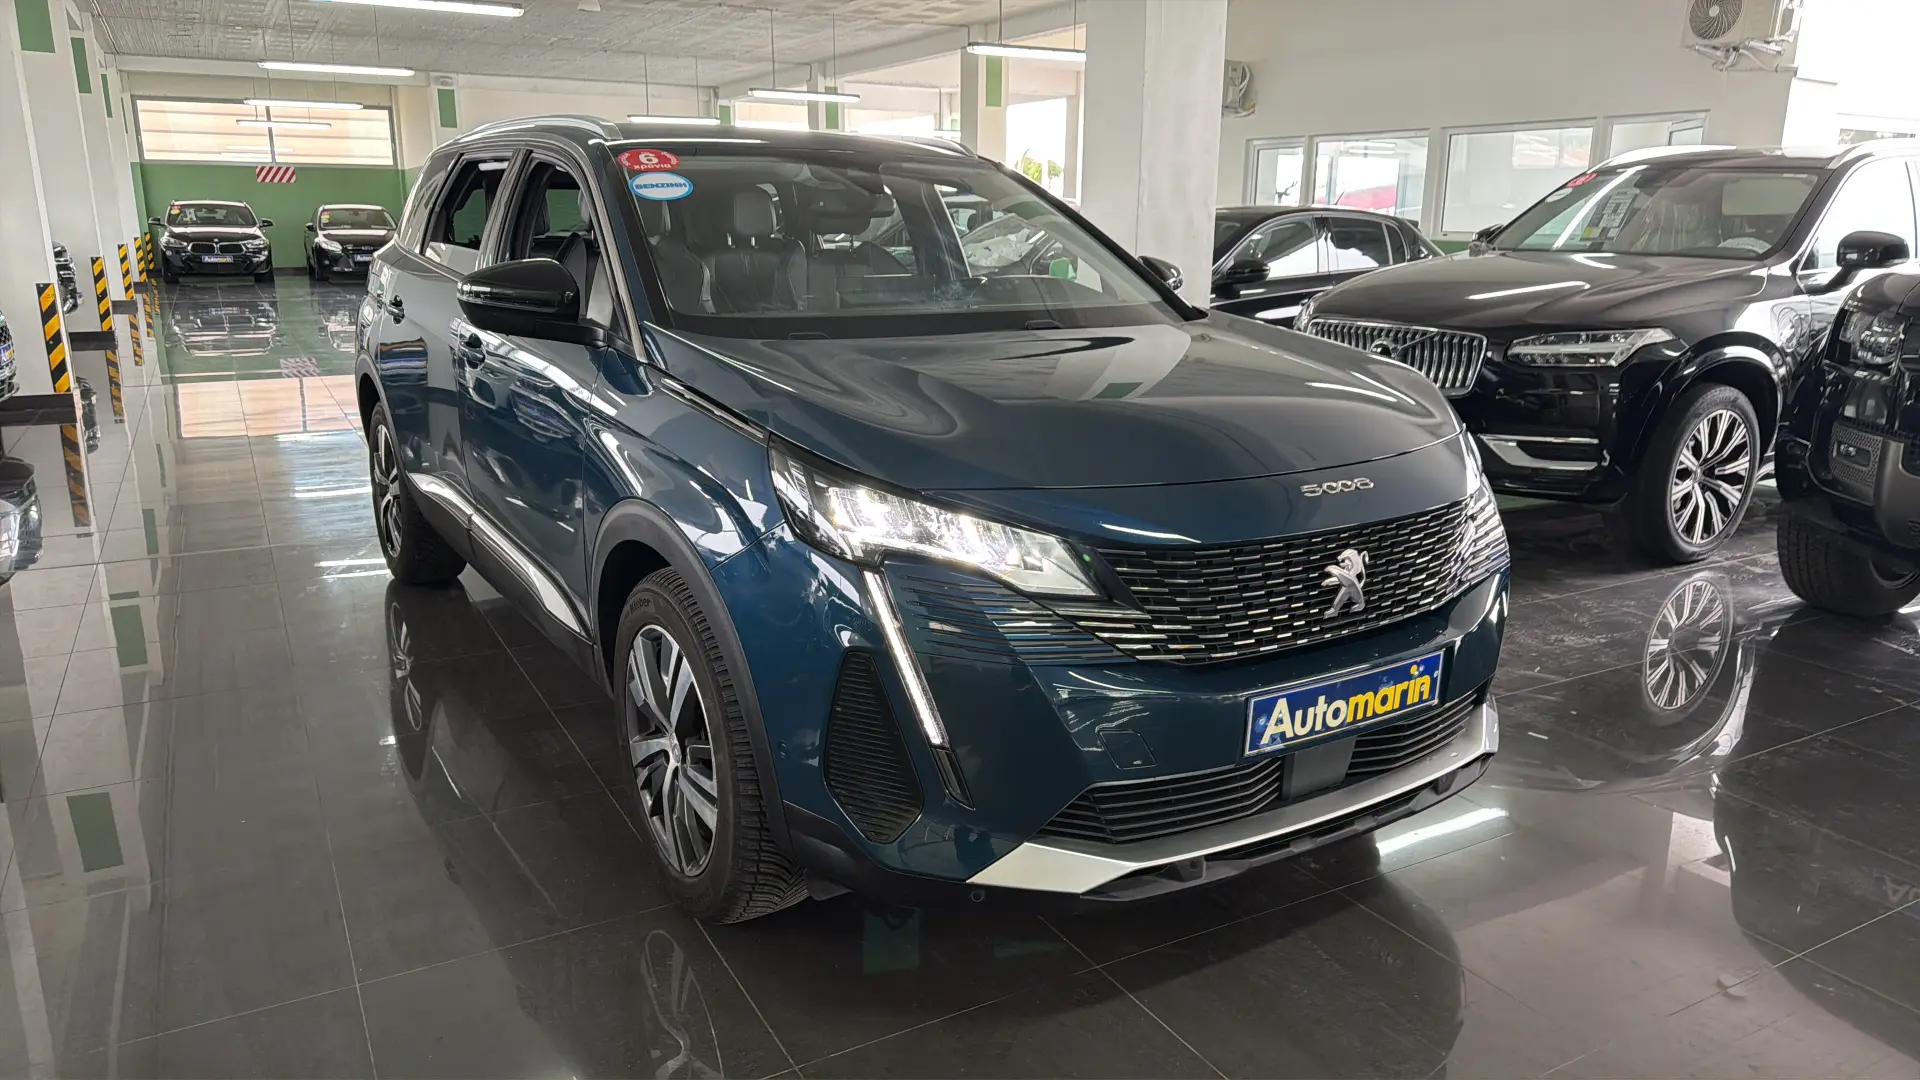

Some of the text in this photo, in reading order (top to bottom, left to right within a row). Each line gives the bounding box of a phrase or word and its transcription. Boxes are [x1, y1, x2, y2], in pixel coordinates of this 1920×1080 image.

[639, 153, 658, 164] 6
[1300, 477, 1374, 497] 5008
[1260, 664, 1431, 745] Automarin
